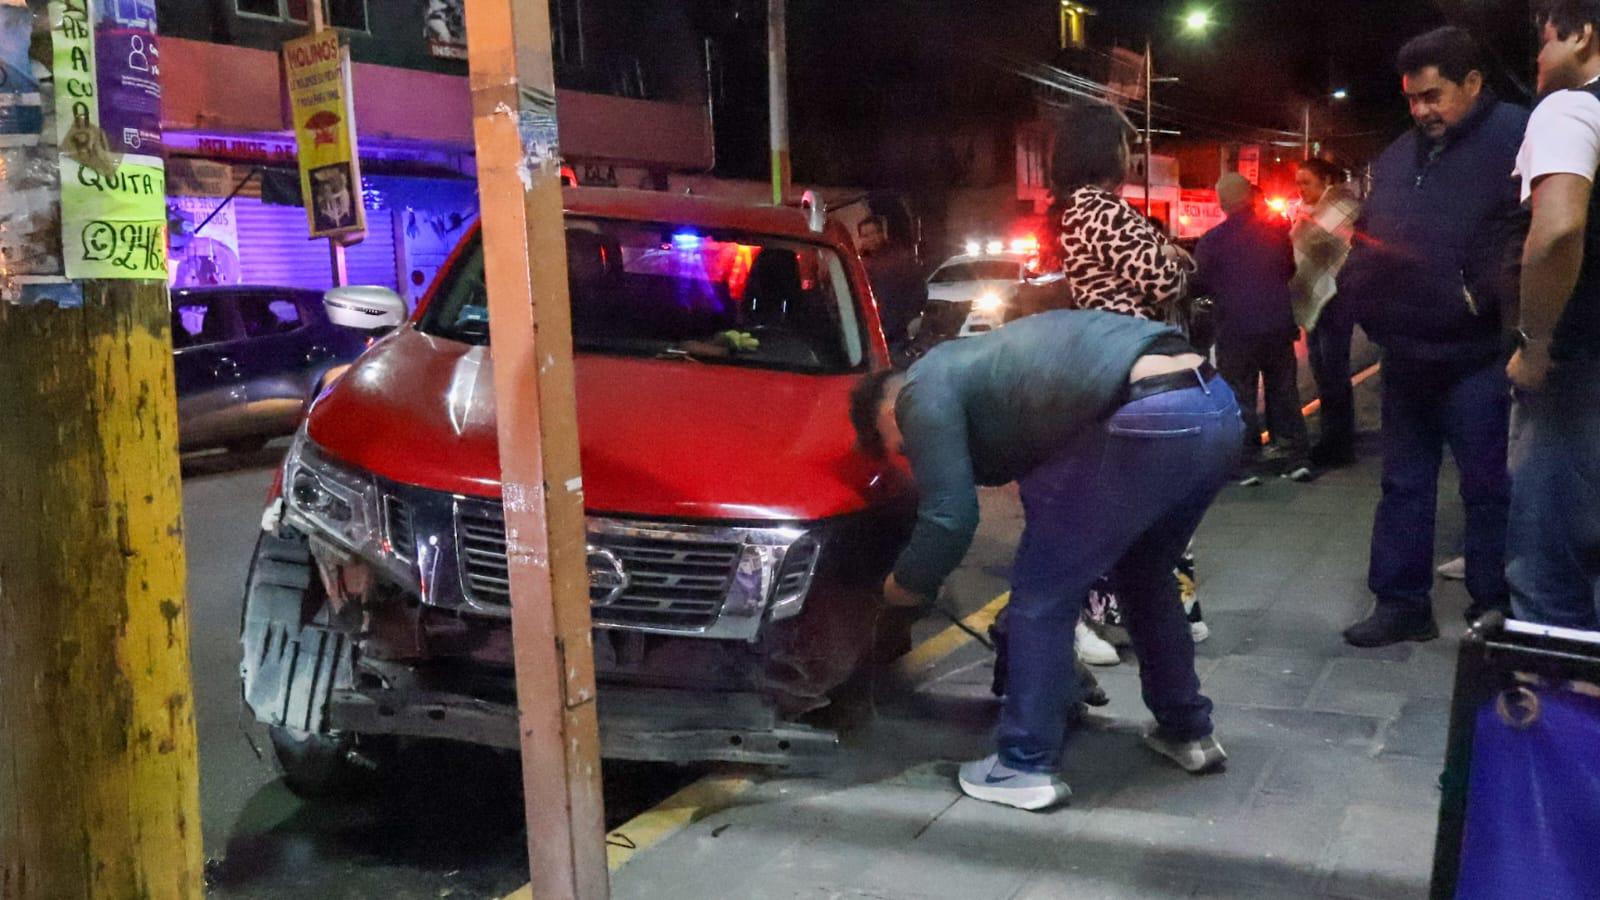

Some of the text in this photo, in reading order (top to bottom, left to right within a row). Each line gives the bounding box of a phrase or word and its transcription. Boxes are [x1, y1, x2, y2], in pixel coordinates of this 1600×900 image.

[286, 37, 338, 69] MOLINOS
[198, 137, 268, 158] MOLINOS
[79, 164, 152, 195] QUITA
